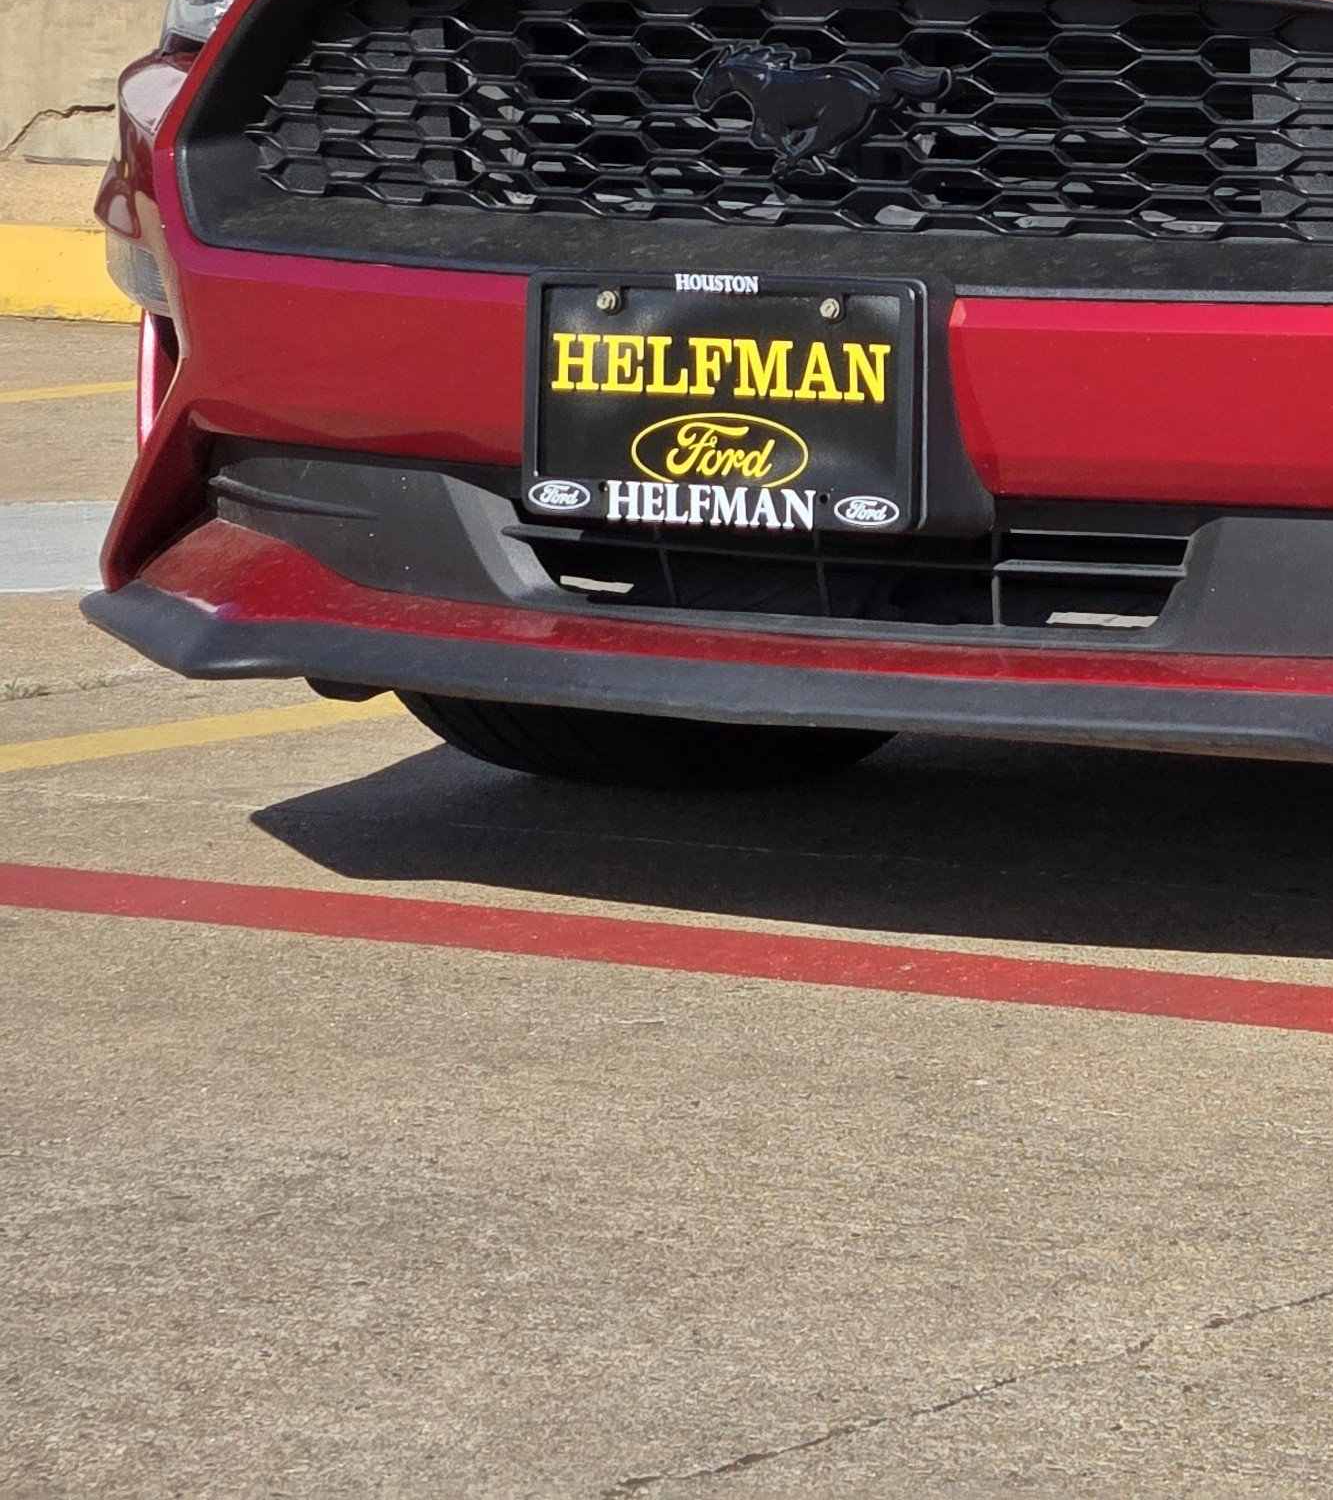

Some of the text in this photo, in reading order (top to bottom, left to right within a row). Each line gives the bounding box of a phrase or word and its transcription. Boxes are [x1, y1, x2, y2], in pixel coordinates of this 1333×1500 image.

[674, 273, 759, 293] HOUSTON
[551, 332, 891, 403] HELFMAN
[666, 421, 776, 478] Ford
[539, 485, 579, 506] Ford
[606, 480, 817, 531] HELFMAN
[845, 499, 889, 522] Ford
